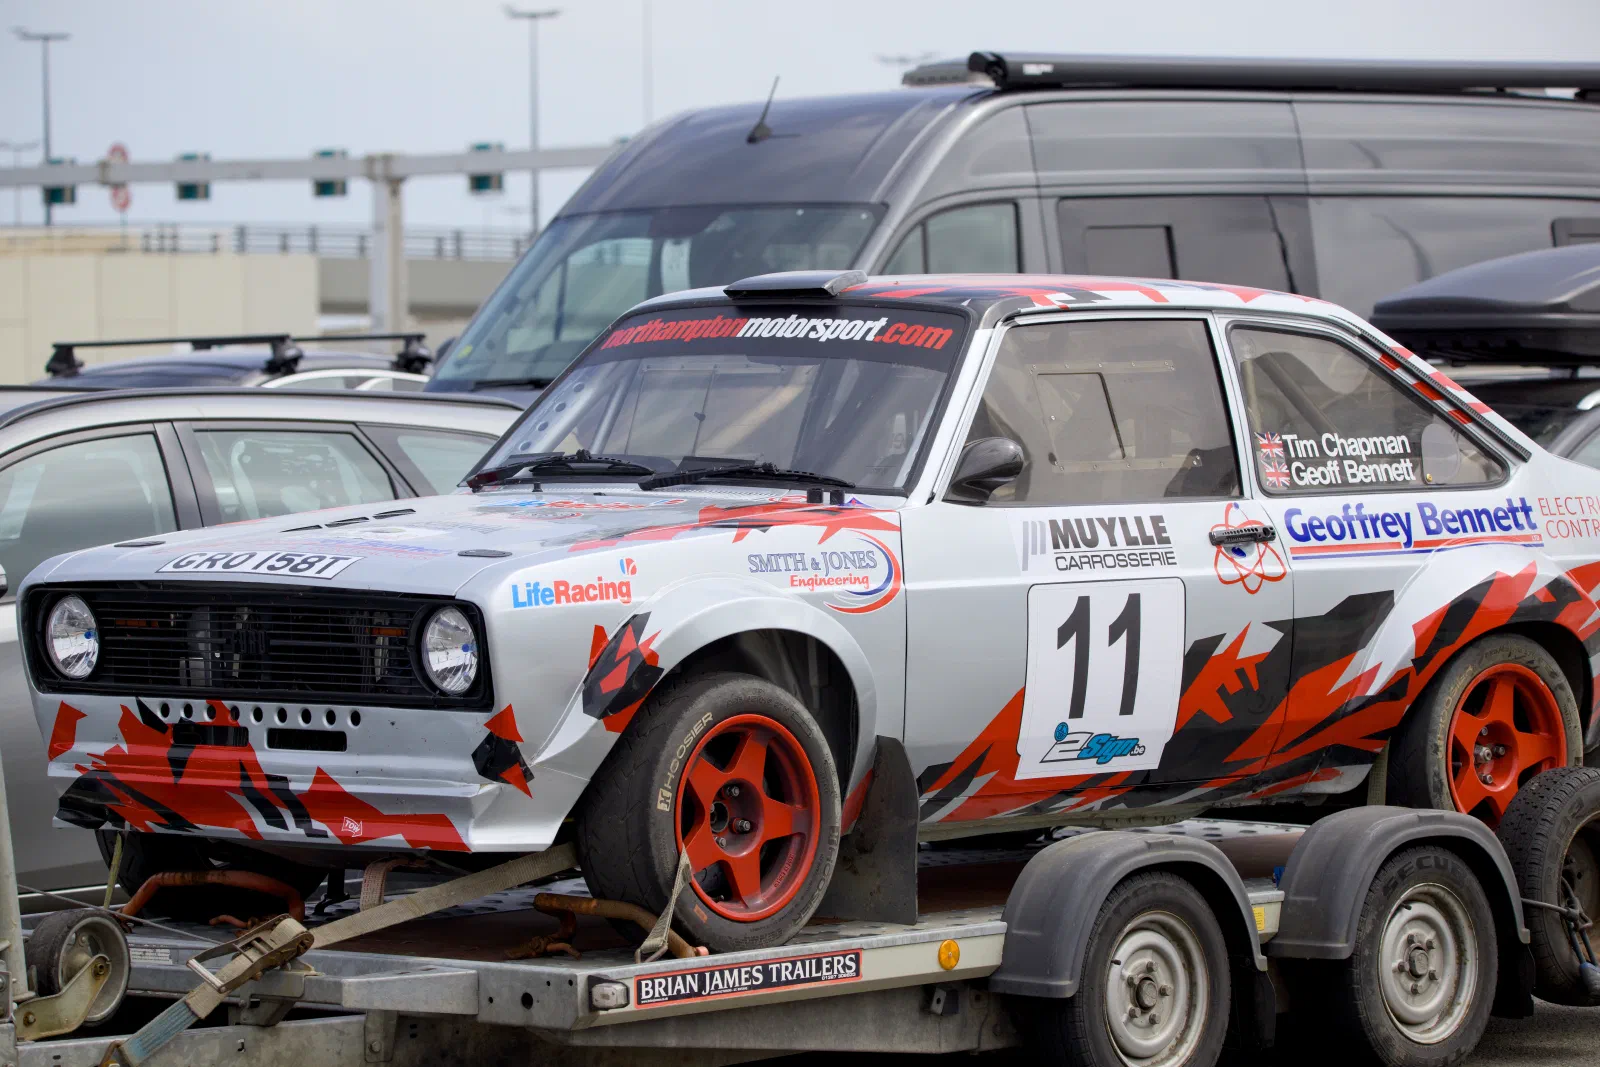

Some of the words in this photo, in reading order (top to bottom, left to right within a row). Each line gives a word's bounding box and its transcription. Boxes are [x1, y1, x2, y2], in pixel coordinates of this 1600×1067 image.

[601, 314, 954, 351] northamptonmotorsport.com
[1281, 434, 1320, 458] Tim
[1321, 432, 1411, 461] Chapman
[1290, 460, 1341, 486] Geoff
[1343, 458, 1416, 484] Bennett
[1048, 515, 1172, 550] MUYLLE
[1284, 502, 1413, 548] Geoffrey
[1416, 497, 1539, 536] Bennett
[172, 551, 258, 570] GRO
[251, 552, 351, 575] 158T
[747, 553, 809, 573] SMITH
[810, 556, 822, 571] &
[820, 550, 878, 577] JONES
[1055, 551, 1178, 571] CARROSSERIE
[511, 576, 633, 609] LifeRacing
[789, 573, 870, 591] Engineering
[1056, 592, 1141, 720] 11
[664, 711, 714, 790] HOOSIER
[345, 819, 361, 833] TOW
[640, 973, 699, 1000] BRIAN
[702, 965, 763, 996] JAMES
[768, 954, 857, 982] TRAILERS
